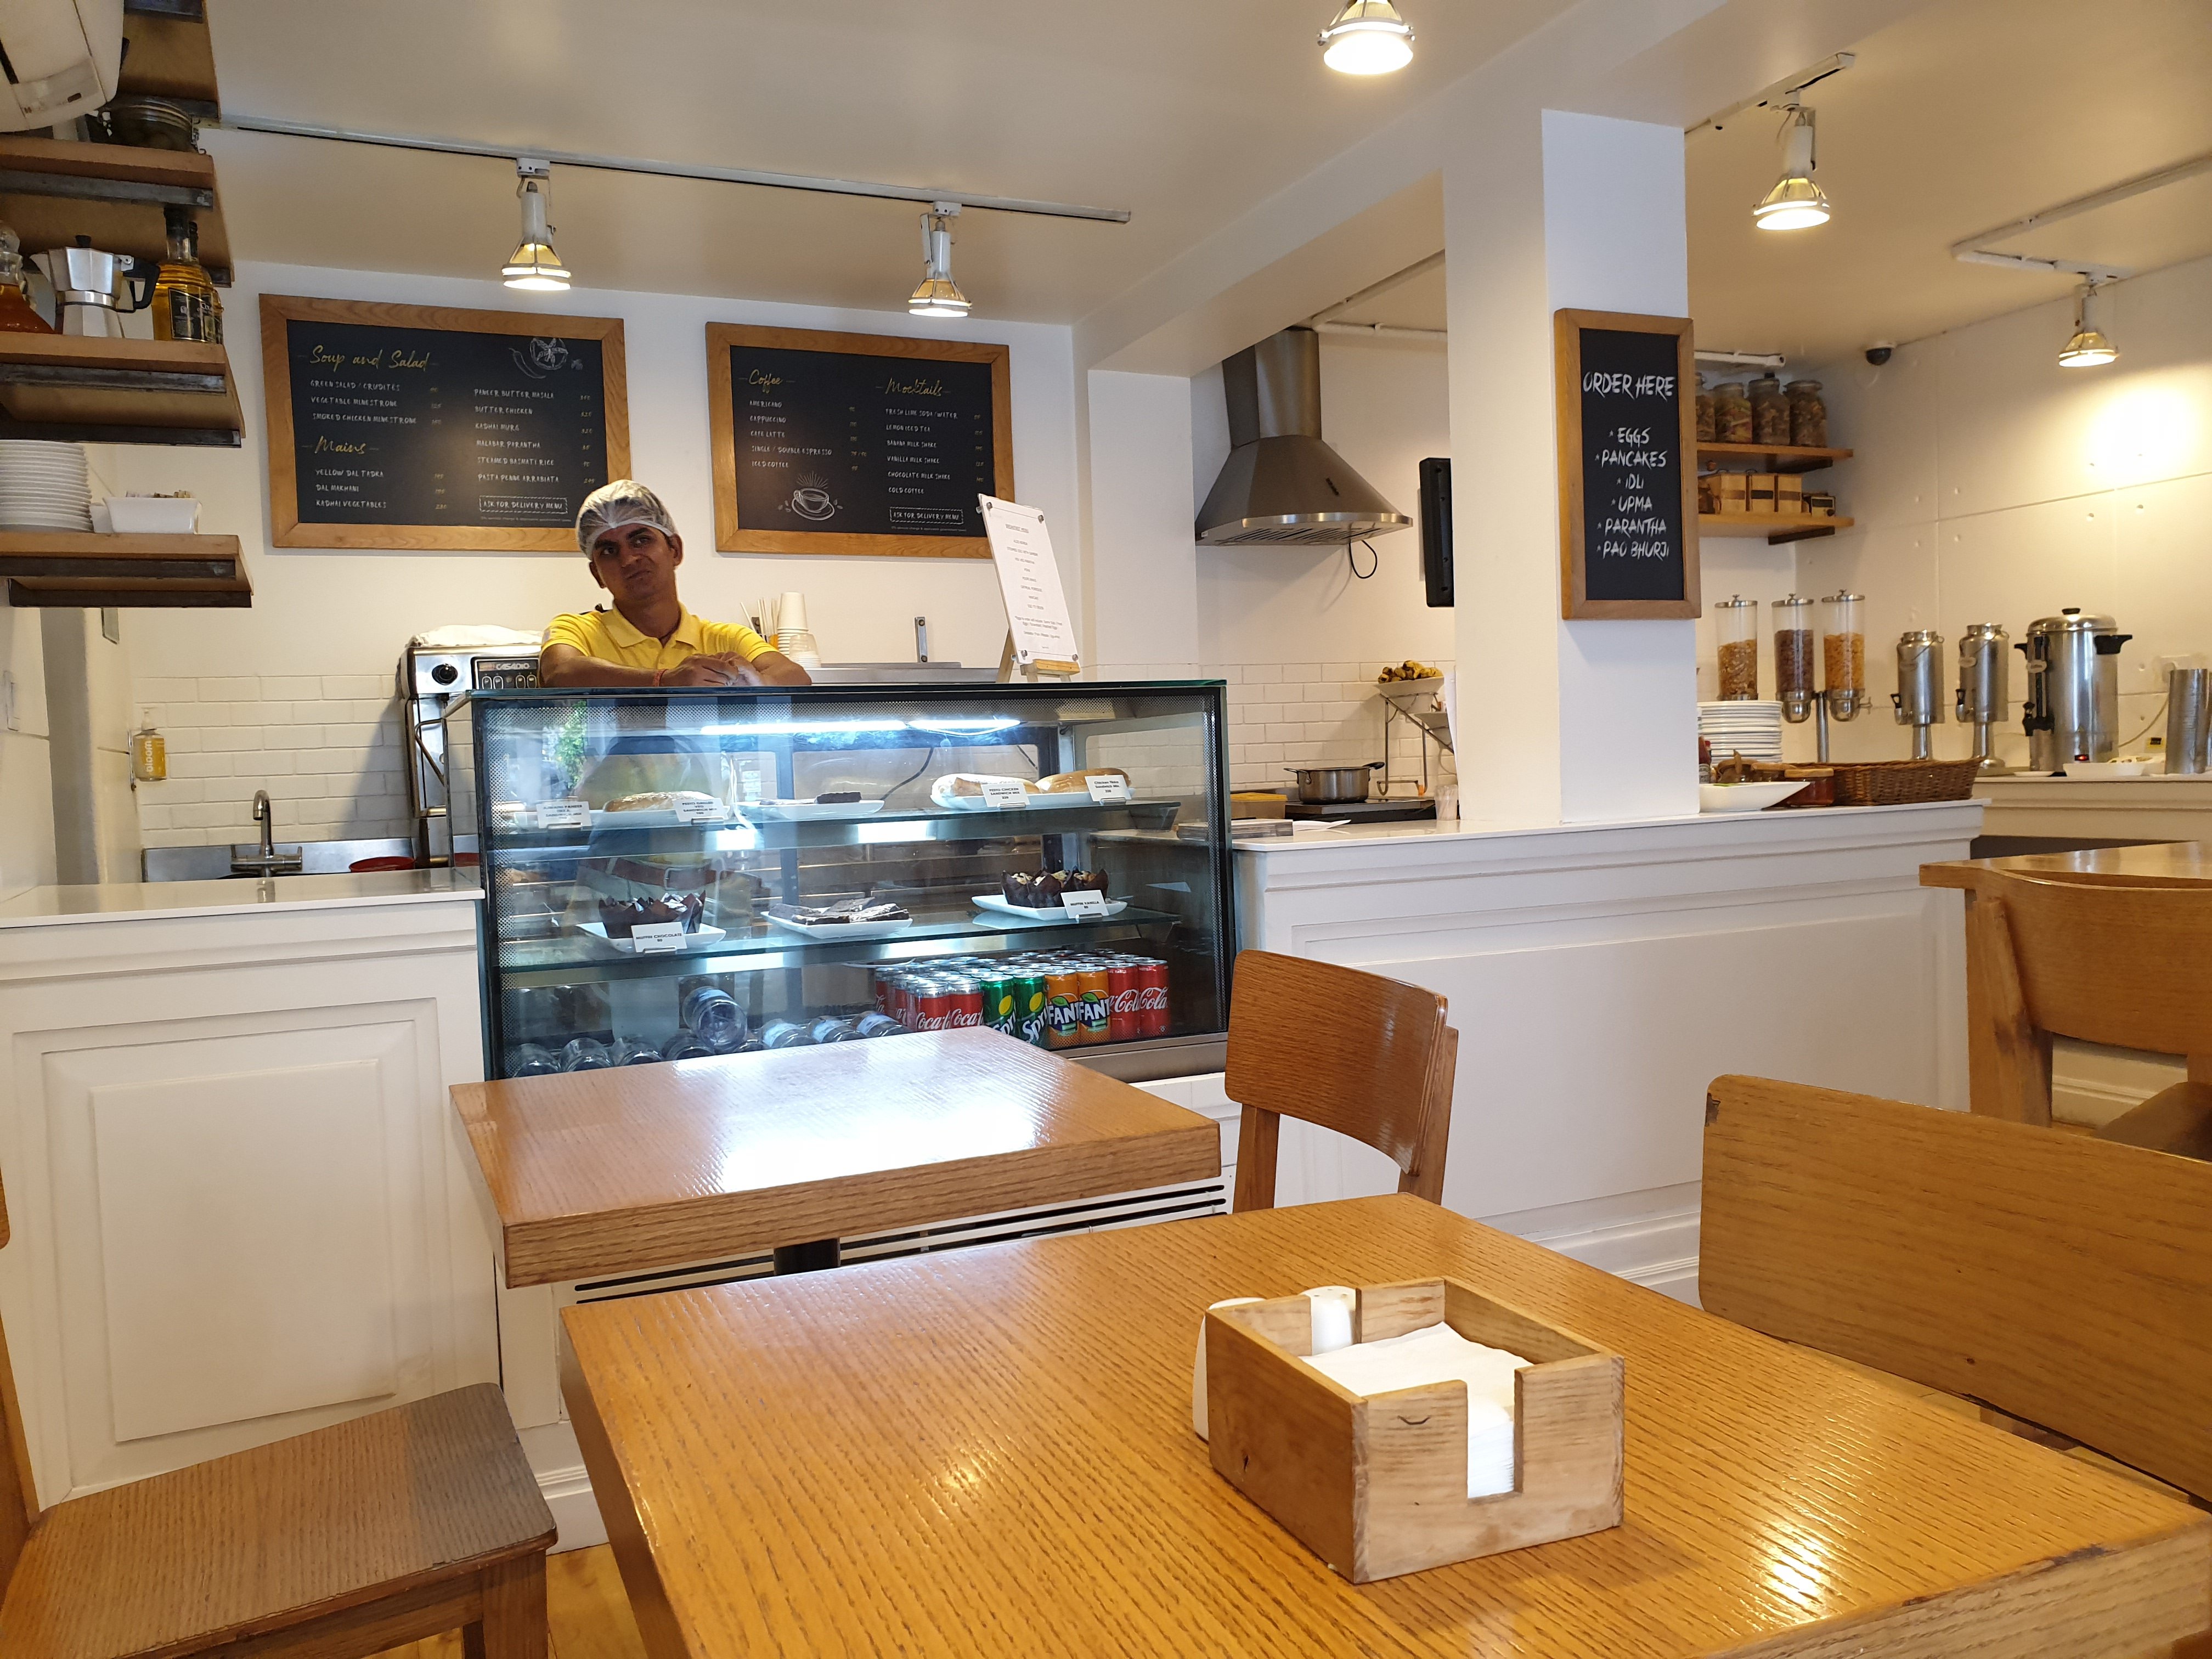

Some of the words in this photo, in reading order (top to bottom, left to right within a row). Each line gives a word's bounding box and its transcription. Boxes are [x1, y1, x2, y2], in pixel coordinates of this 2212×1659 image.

[310, 345, 345, 373] Soup
[353, 349, 383, 369] and
[388, 349, 430, 371] Salad
[310, 379, 334, 388] GREEN
[335, 381, 357, 389] SALAD
[363, 383, 400, 391] CRUDITES
[749, 369, 783, 393] Coffee
[1583, 371, 1635, 400] ORDER
[1635, 374, 1675, 402] HERE
[885, 377, 943, 397] Mocktails
[474, 388, 500, 397] PANEER
[501, 390, 531, 399] BUTTER
[532, 391, 555, 399] MASALA
[311, 396, 351, 405] VEGETABLE
[353, 399, 397, 408] MINESTRONE
[749, 399, 782, 408] AMERICANO
[475, 405, 505, 414] BUTTER
[313, 413, 341, 421] SMOKED
[342, 414, 371, 422] CHICKEN
[373, 415, 417, 425] MINESTRONE
[749, 415, 787, 424] CAPPUCCINO
[937, 411, 958, 420] WATER
[500, 424, 520, 432] MURG
[1617, 427, 1651, 448] EGGS
[314, 436, 366, 454] Mains
[476, 439, 505, 448] MALABAR
[506, 441, 541, 449] PARANTHA
[778, 446, 800, 454] DOUBLE
[802, 448, 832, 456] ESPRESSO
[477, 456, 508, 465] STEAMED
[509, 457, 537, 465] BASMATI
[1601, 449, 1668, 470] PANCAKES
[477, 473, 499, 482] PASTA
[500, 474, 521, 483] PENNE
[522, 475, 559, 483] ARRABIATA
[888, 471, 920, 479] CHOCOLATE
[1625, 473, 1644, 490] IDLI
[330, 484, 359, 493] MAKHANI
[316, 499, 341, 507] KADHAI
[343, 500, 387, 509] VEGETABLES
[511, 501, 544, 510] DELIVERY
[1618, 495, 1652, 515] UPMA
[1605, 517, 1667, 539] PARANTHA
[1602, 540, 1628, 560] PAO
[1631, 540, 1669, 562] BHURJI
